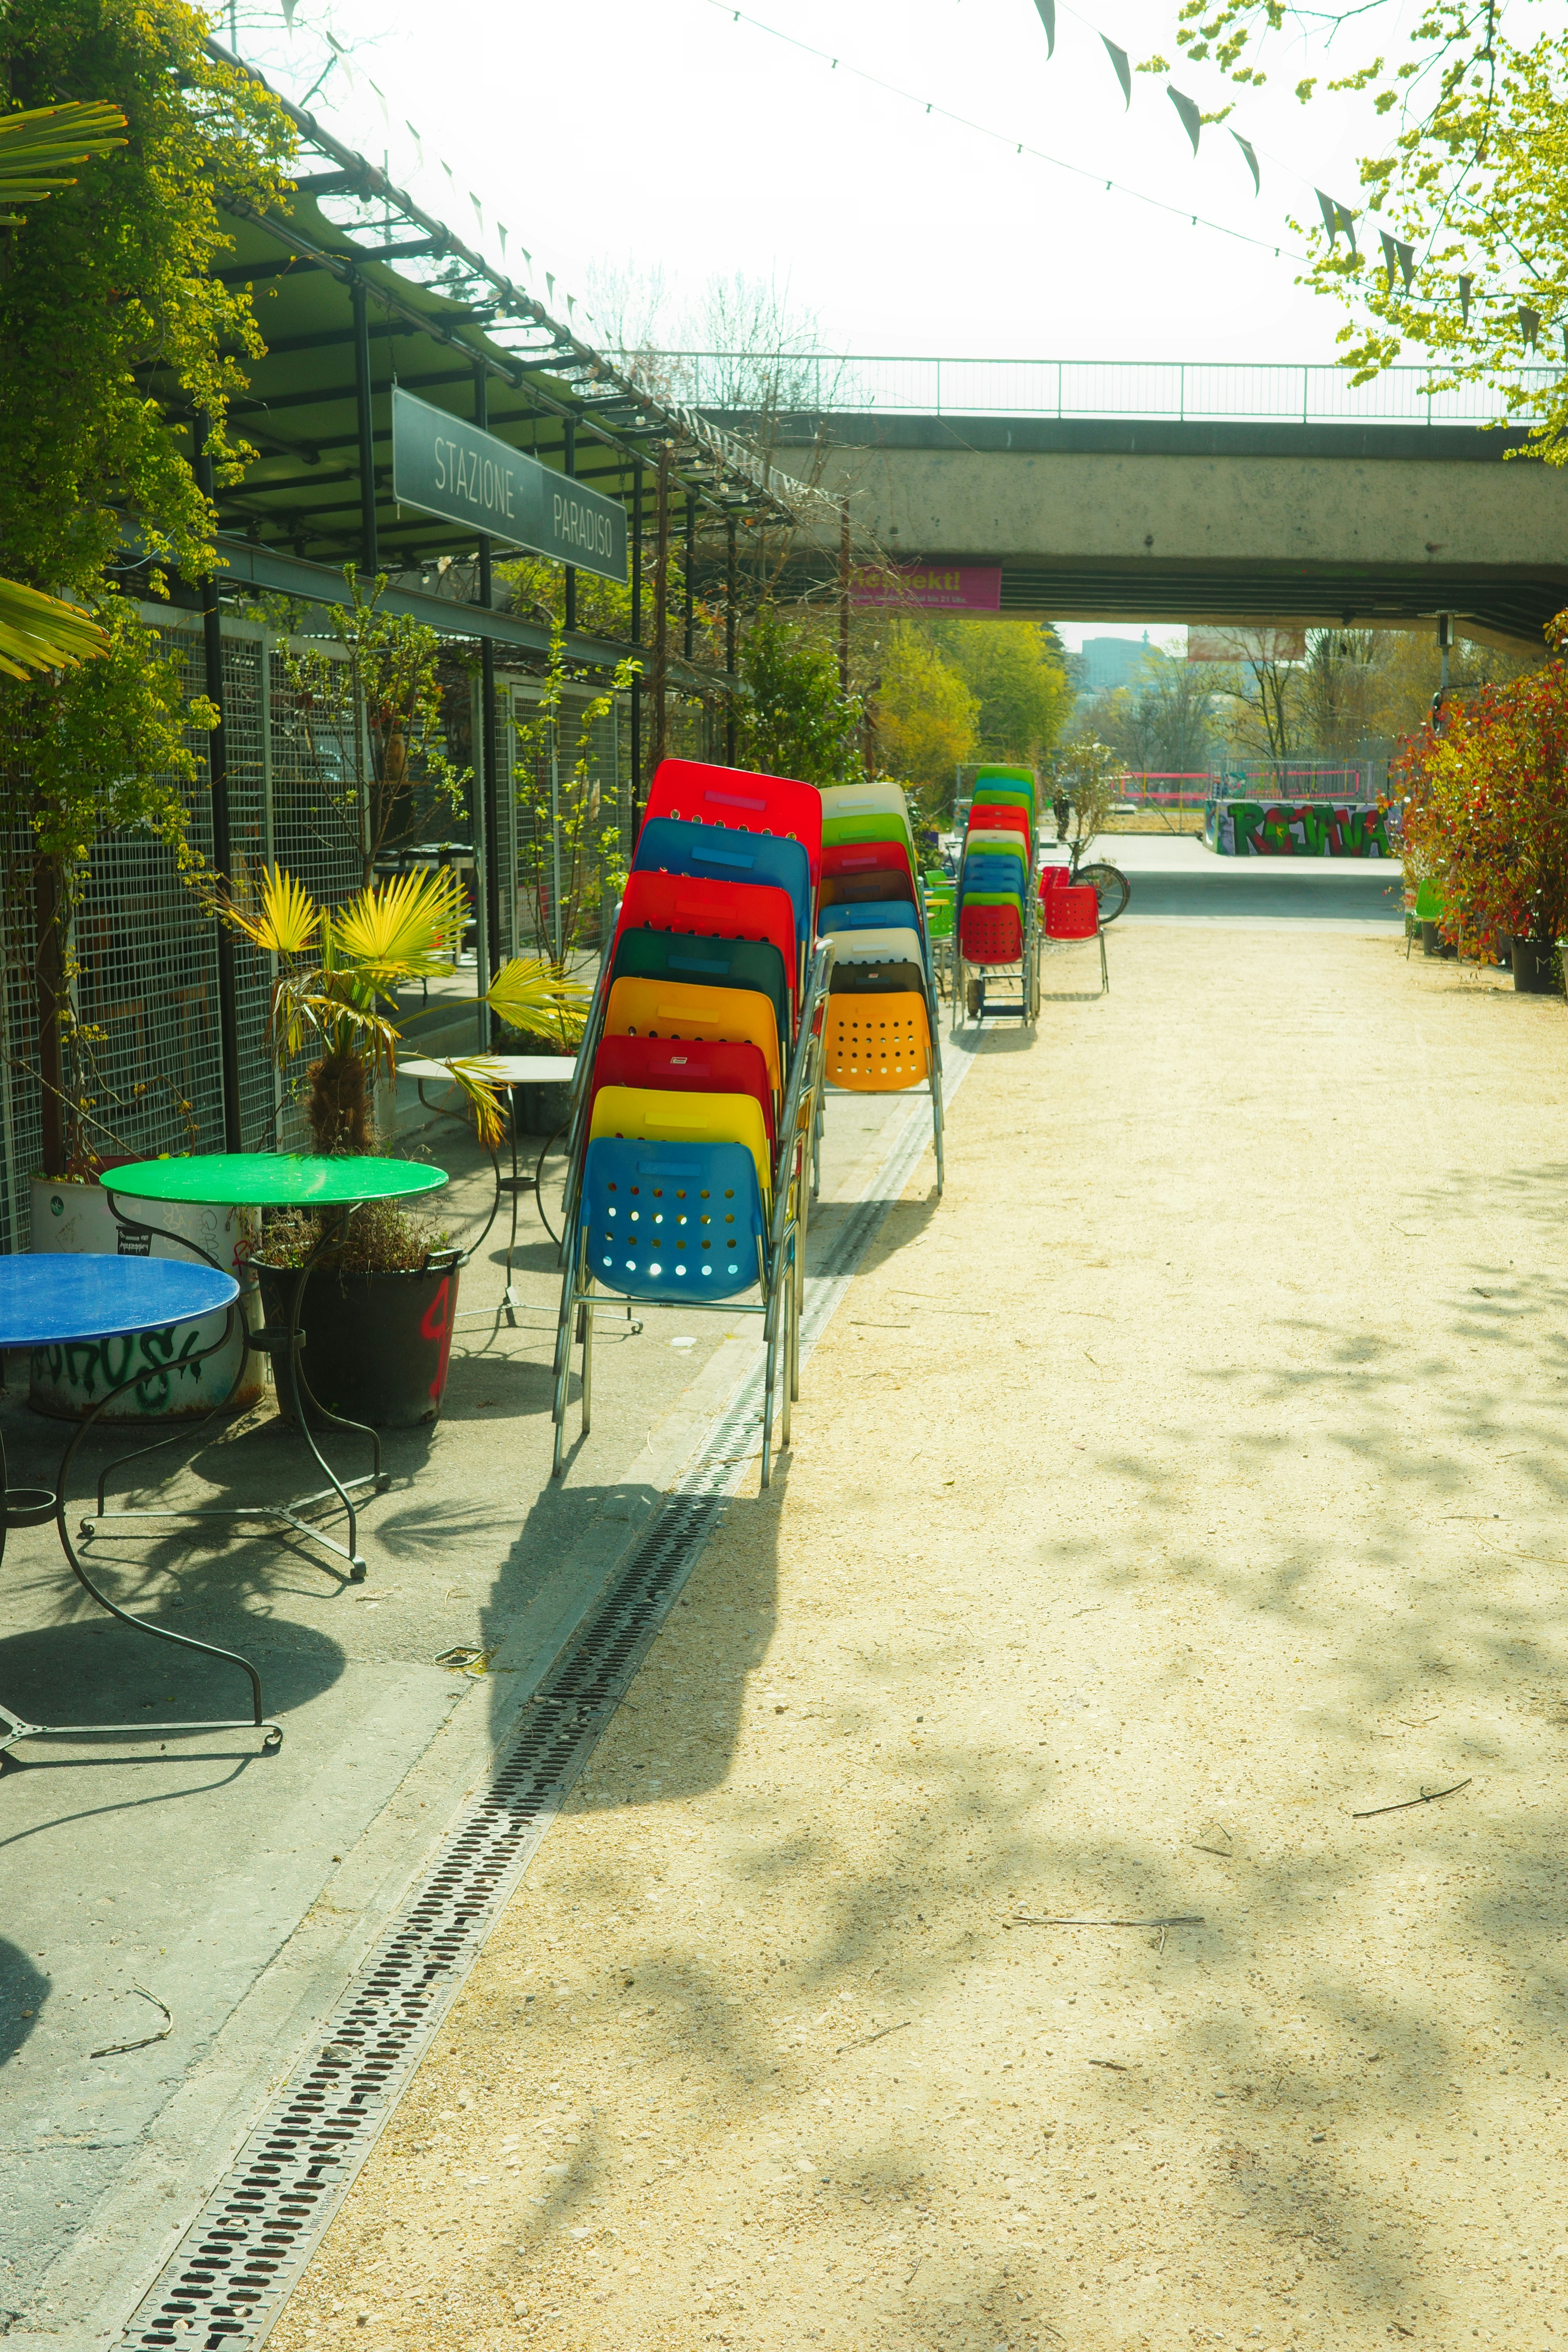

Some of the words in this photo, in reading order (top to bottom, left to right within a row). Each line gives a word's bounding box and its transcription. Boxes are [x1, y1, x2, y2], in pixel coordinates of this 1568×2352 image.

[435, 437, 515, 519] STAZIONE
[554, 494, 612, 558] PARADISO
[289, 2068, 308, 2086] ACO
[136, 2298, 159, 2323] ACO
